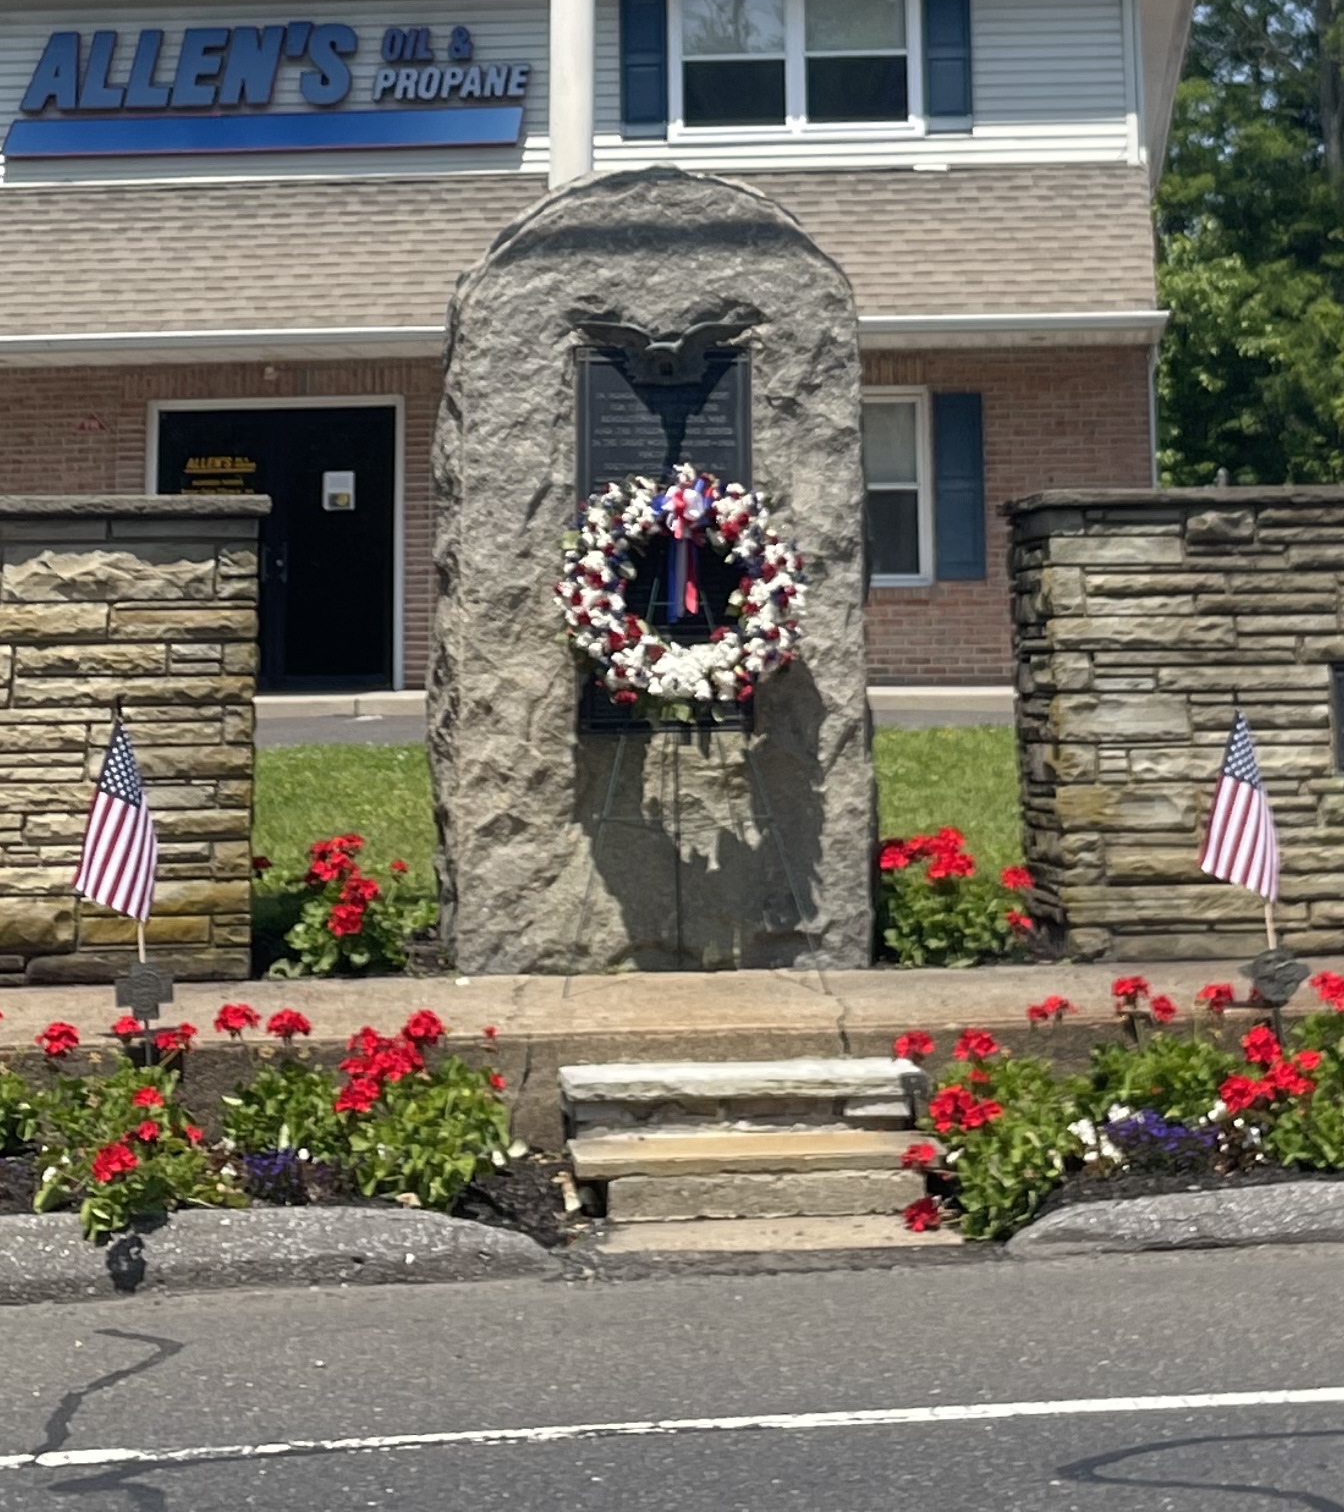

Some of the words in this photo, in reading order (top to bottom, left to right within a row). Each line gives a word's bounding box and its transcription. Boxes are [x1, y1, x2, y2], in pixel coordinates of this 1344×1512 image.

[381, 27, 433, 62] OIL
[448, 26, 473, 60] &
[19, 21, 358, 114] ALLEN'S
[372, 63, 530, 102] PROPANE
